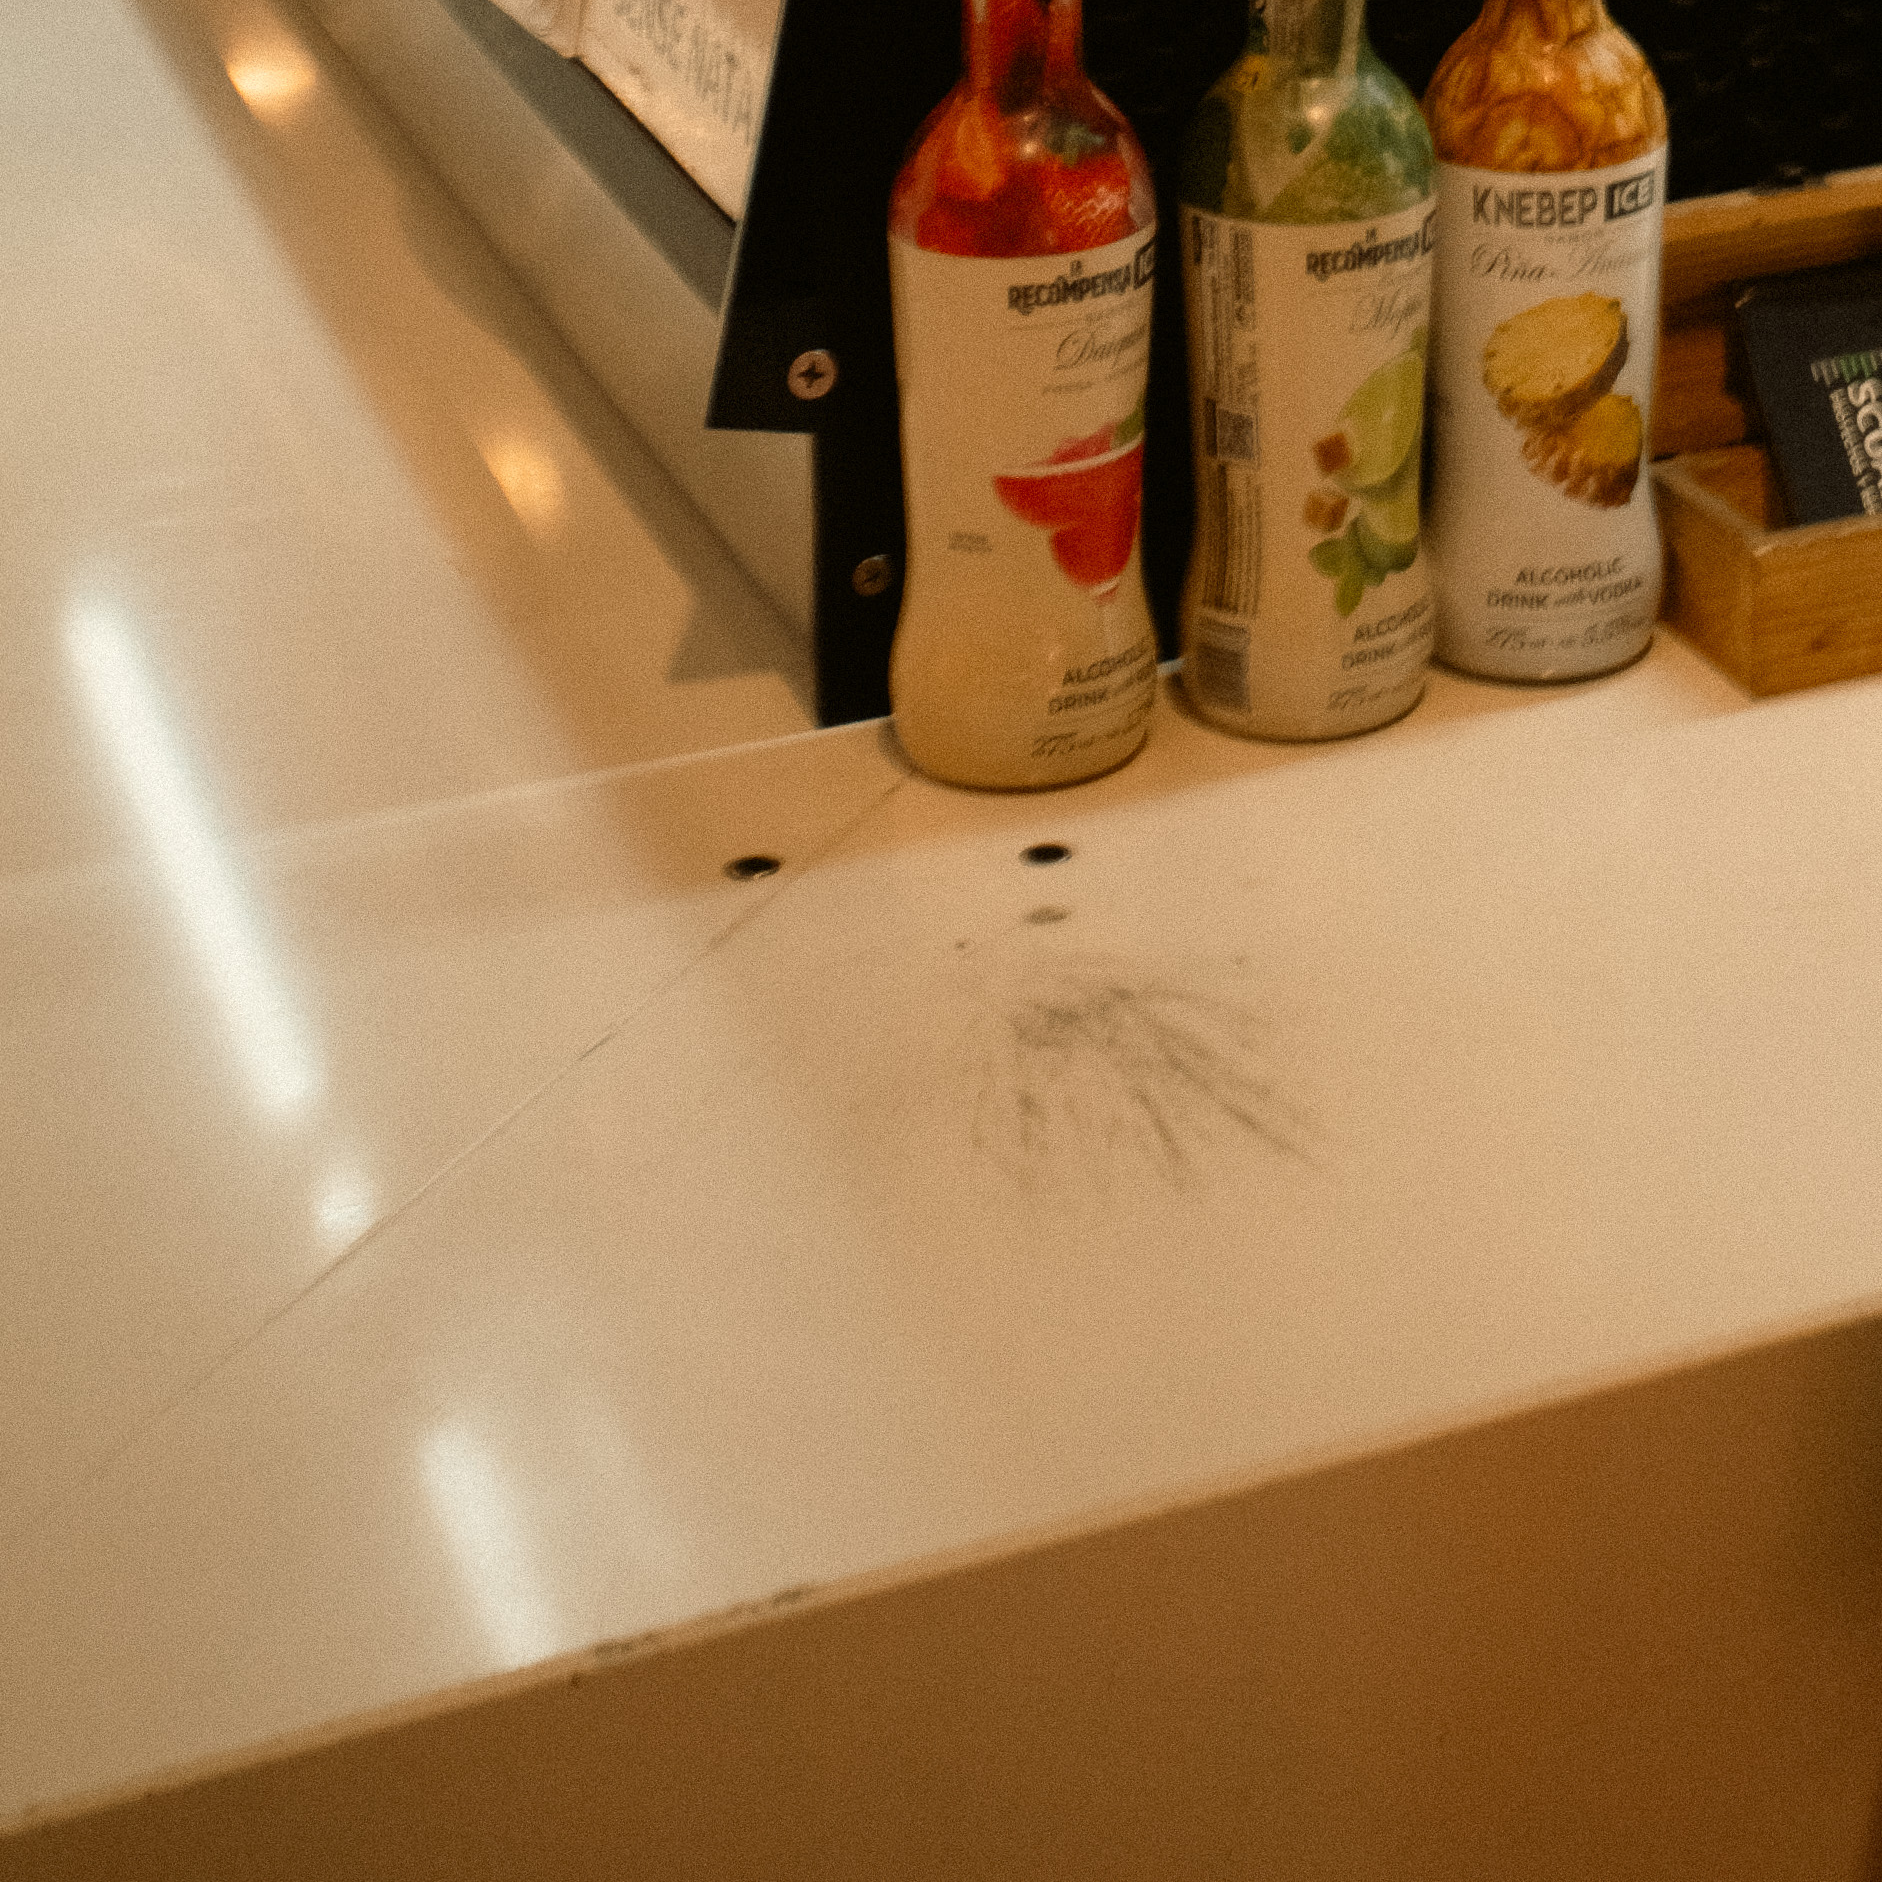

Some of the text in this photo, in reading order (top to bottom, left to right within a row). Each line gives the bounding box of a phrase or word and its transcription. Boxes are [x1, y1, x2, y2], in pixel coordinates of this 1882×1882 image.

[1472, 185, 1598, 229] KNEBEP
[1008, 264, 1133, 317] RECOMPENSA
[1514, 556, 1622, 586] ALCOHOLIC
[1485, 589, 1550, 612] DRINK
[1047, 689, 1108, 716] DRINK
